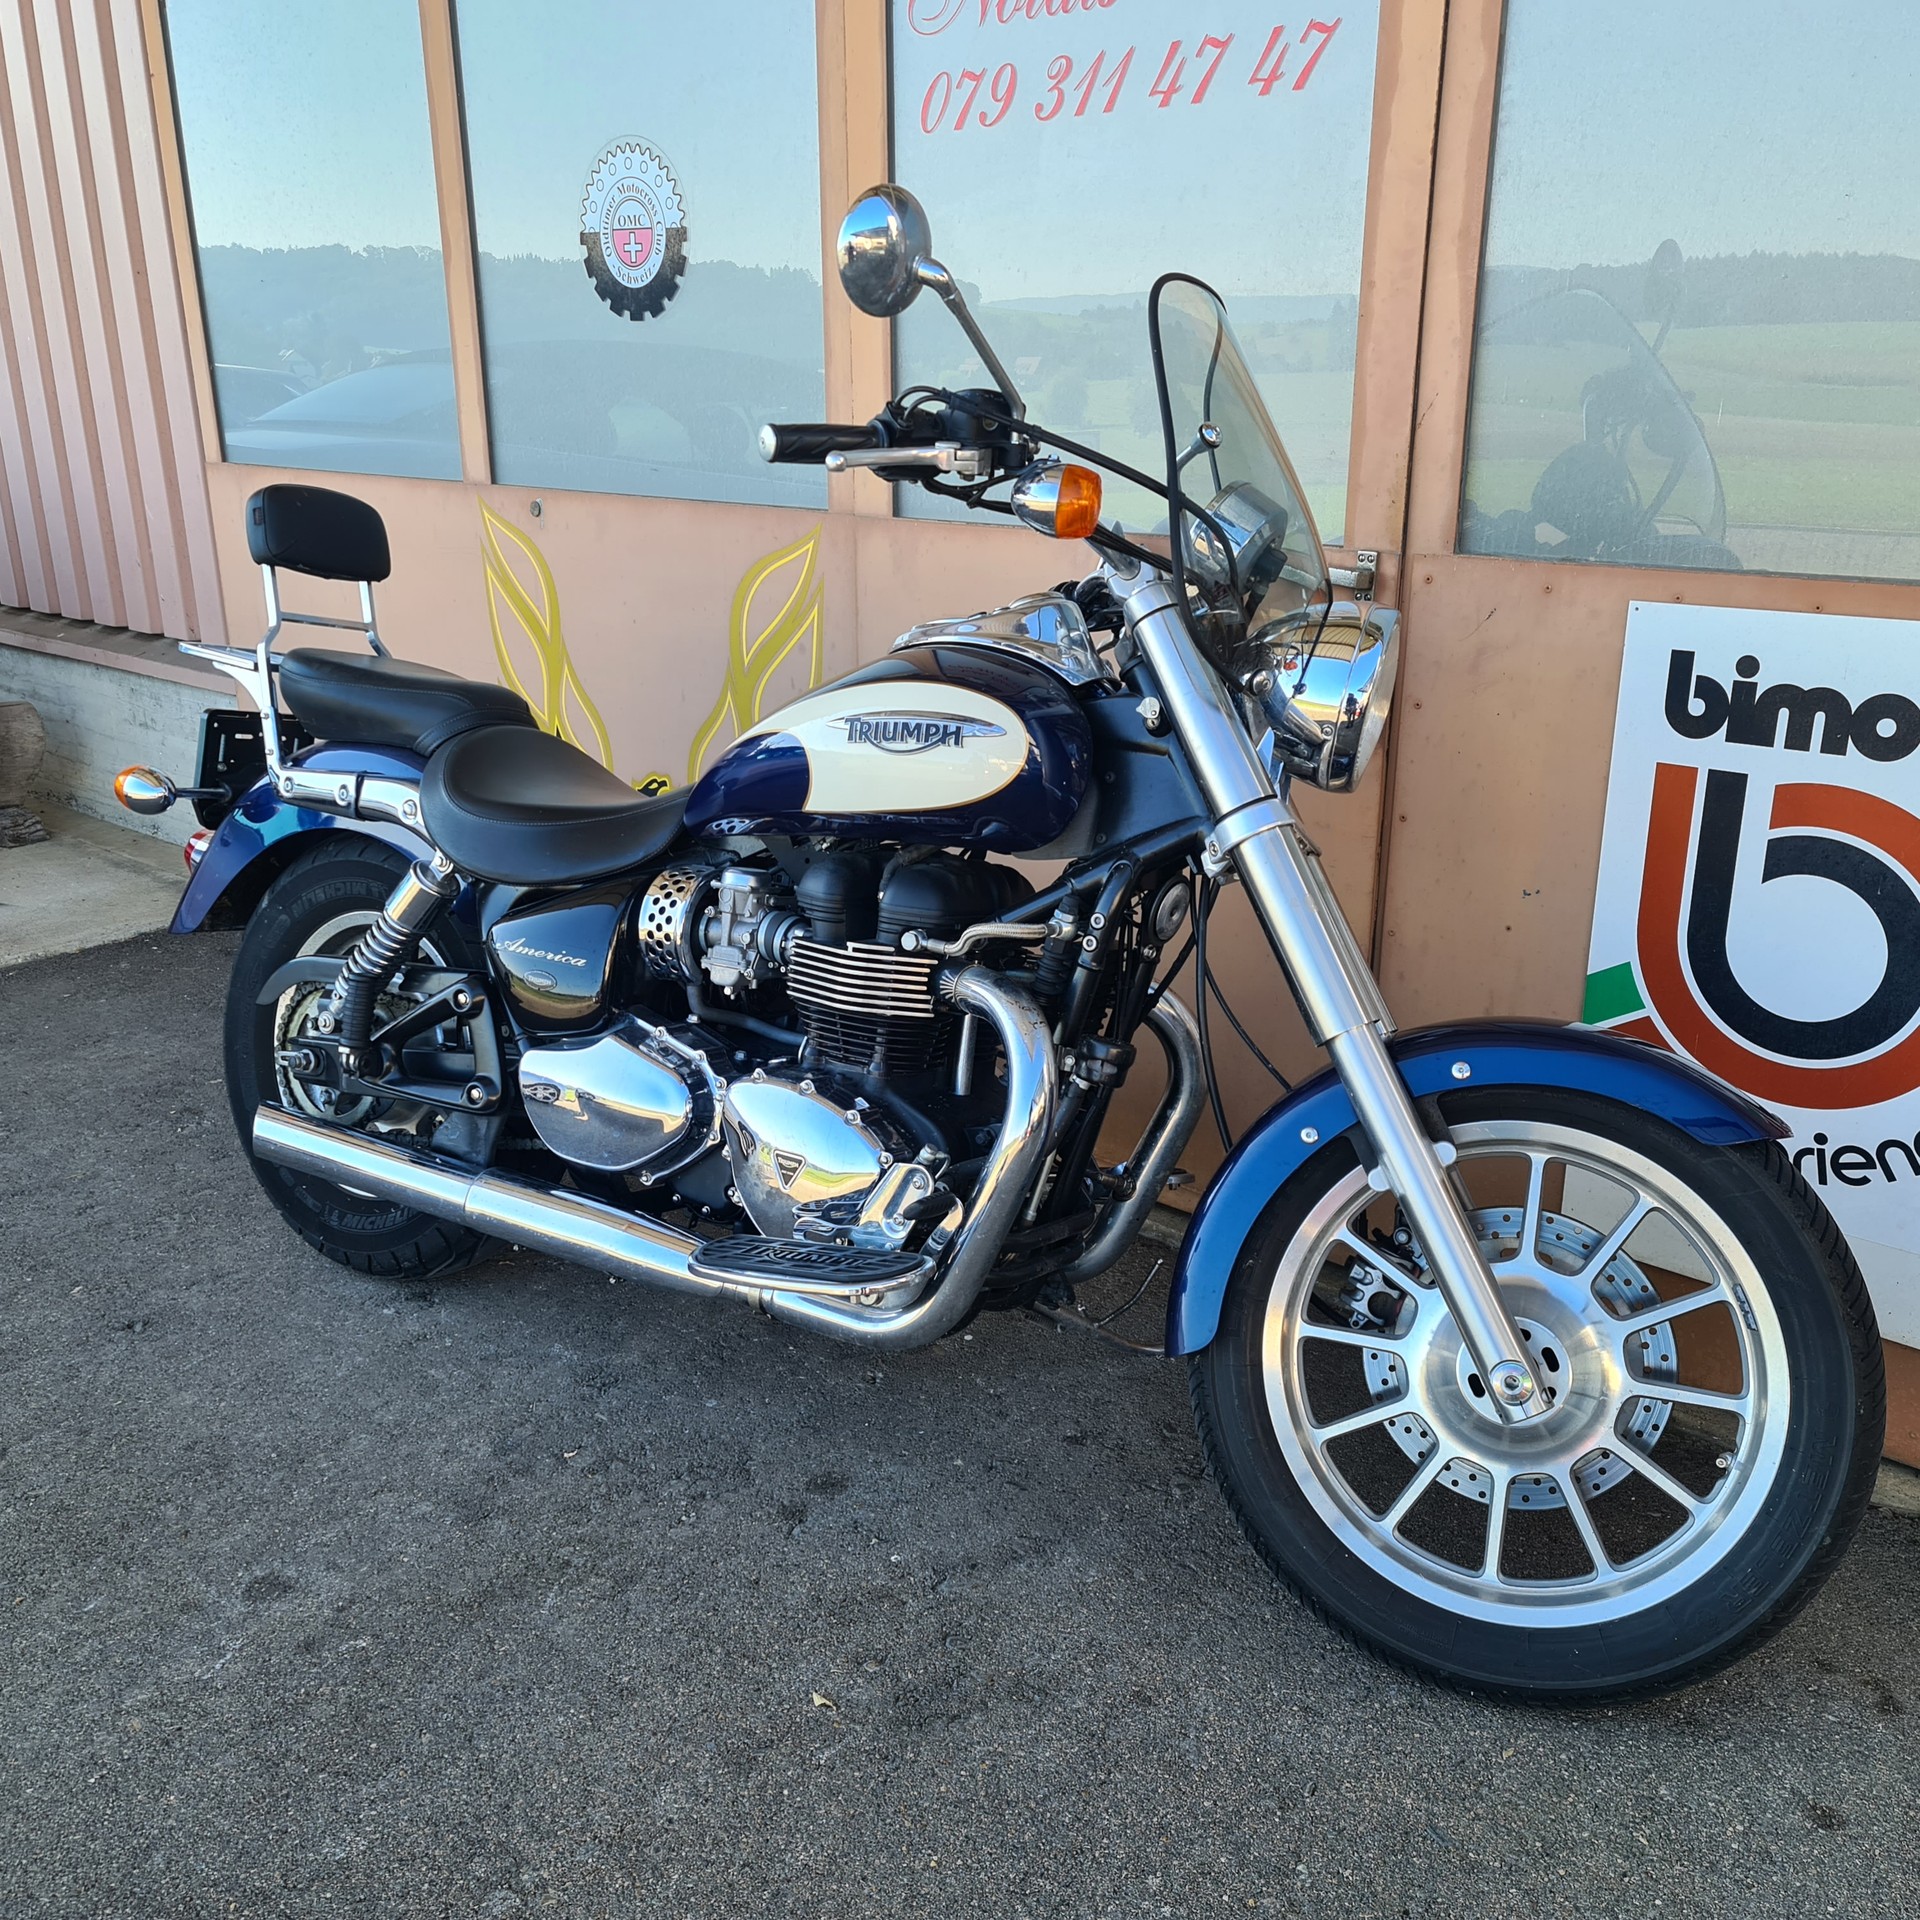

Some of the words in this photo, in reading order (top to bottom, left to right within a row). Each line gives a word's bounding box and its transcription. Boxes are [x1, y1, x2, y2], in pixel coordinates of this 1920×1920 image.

[920, 63, 1018, 134] 079
[1034, 45, 1136, 122] 311
[1148, 32, 1236, 109] 47
[1248, 17, 1343, 97] 47
[602, 194, 617, 258] Oldtimer
[616, 183, 658, 217] Motocross
[655, 221, 664, 256] Club
[618, 214, 646, 227] OMC
[616, 266, 653, 284] Schweiz
[1665, 649, 1920, 762] bimo
[844, 716, 964, 756] TRIUMPH
[496, 937, 588, 967] America
[1776, 1130, 1920, 1187] rien
